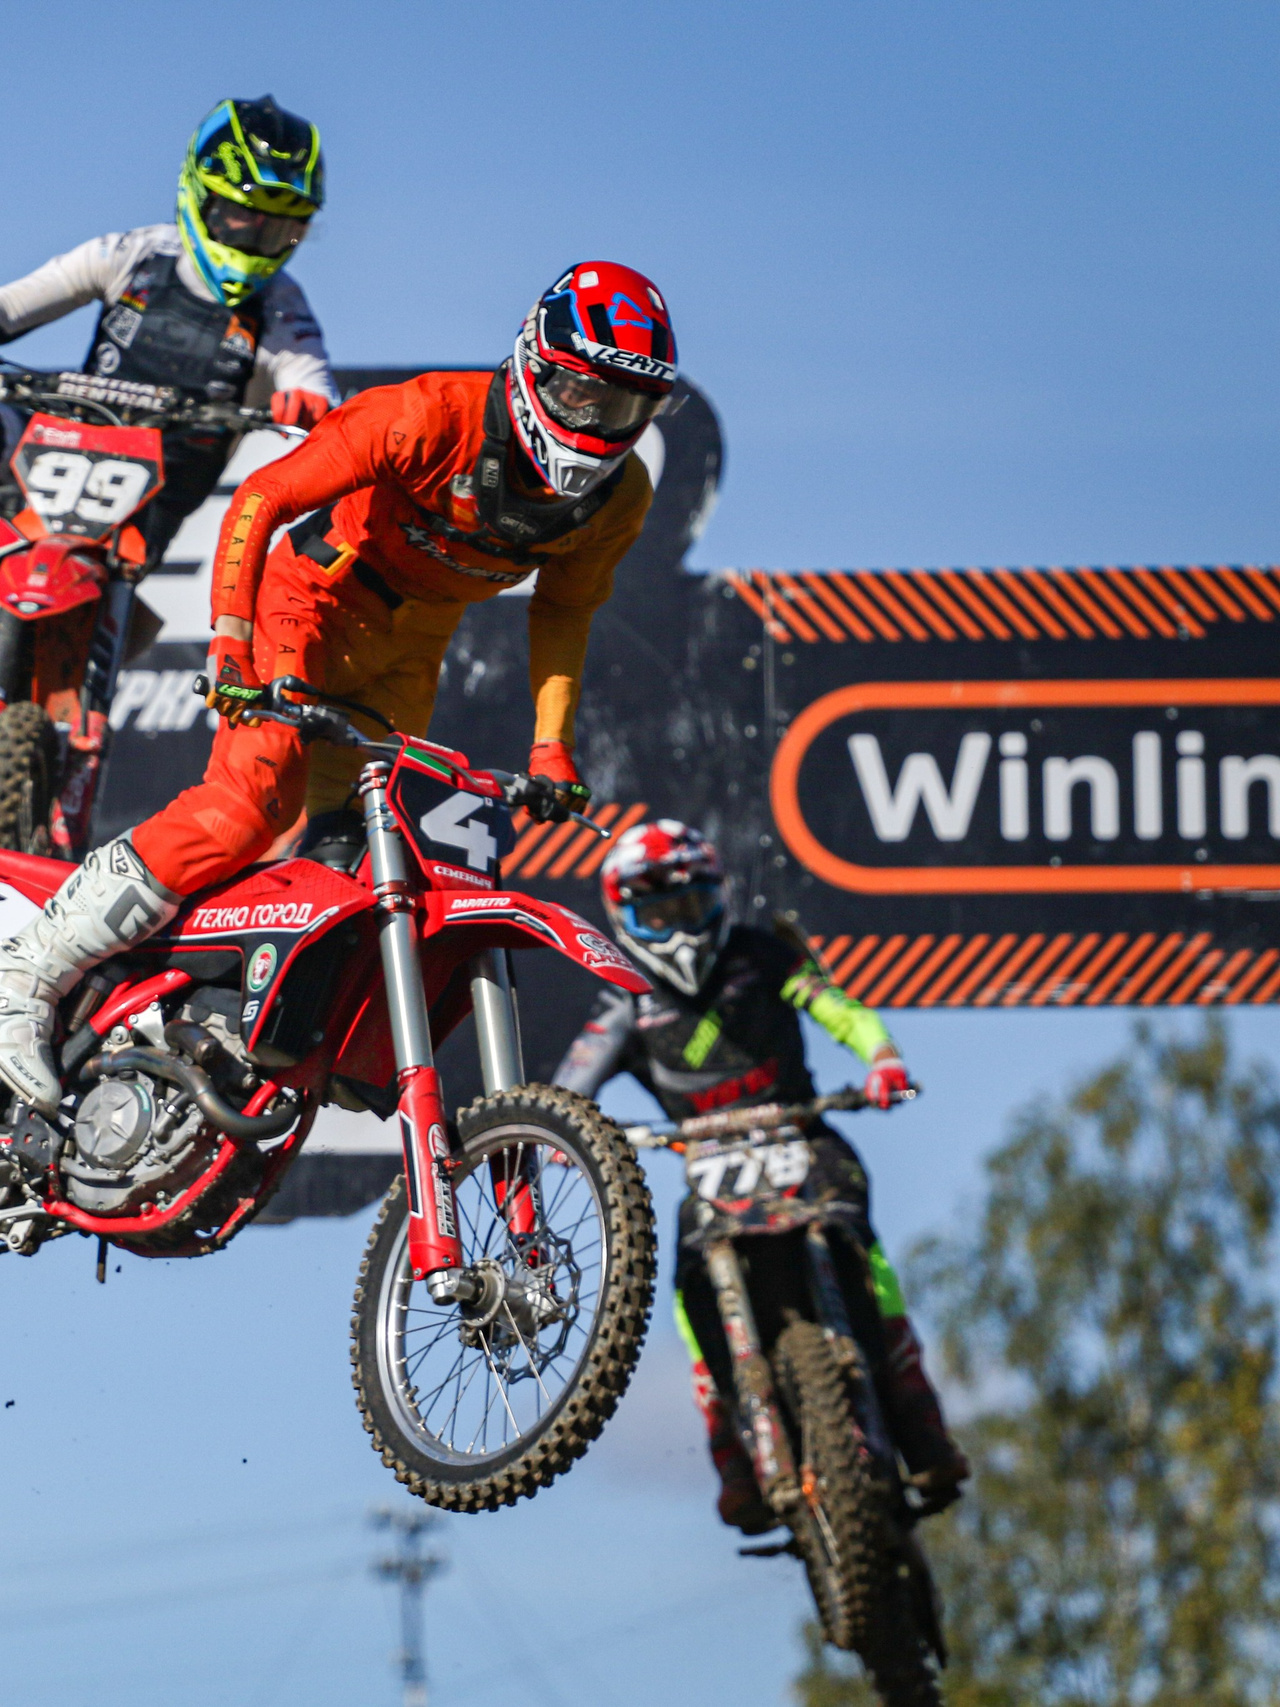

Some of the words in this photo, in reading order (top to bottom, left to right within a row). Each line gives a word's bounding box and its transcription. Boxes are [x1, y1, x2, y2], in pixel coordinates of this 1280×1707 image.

[26, 450, 152, 524] 99
[278, 596, 307, 654] LEA
[218, 683, 264, 700] LEATT
[420, 790, 498, 872] 4
[191, 906, 250, 929] ТЕХНО
[250, 902, 314, 926] ГОРОД
